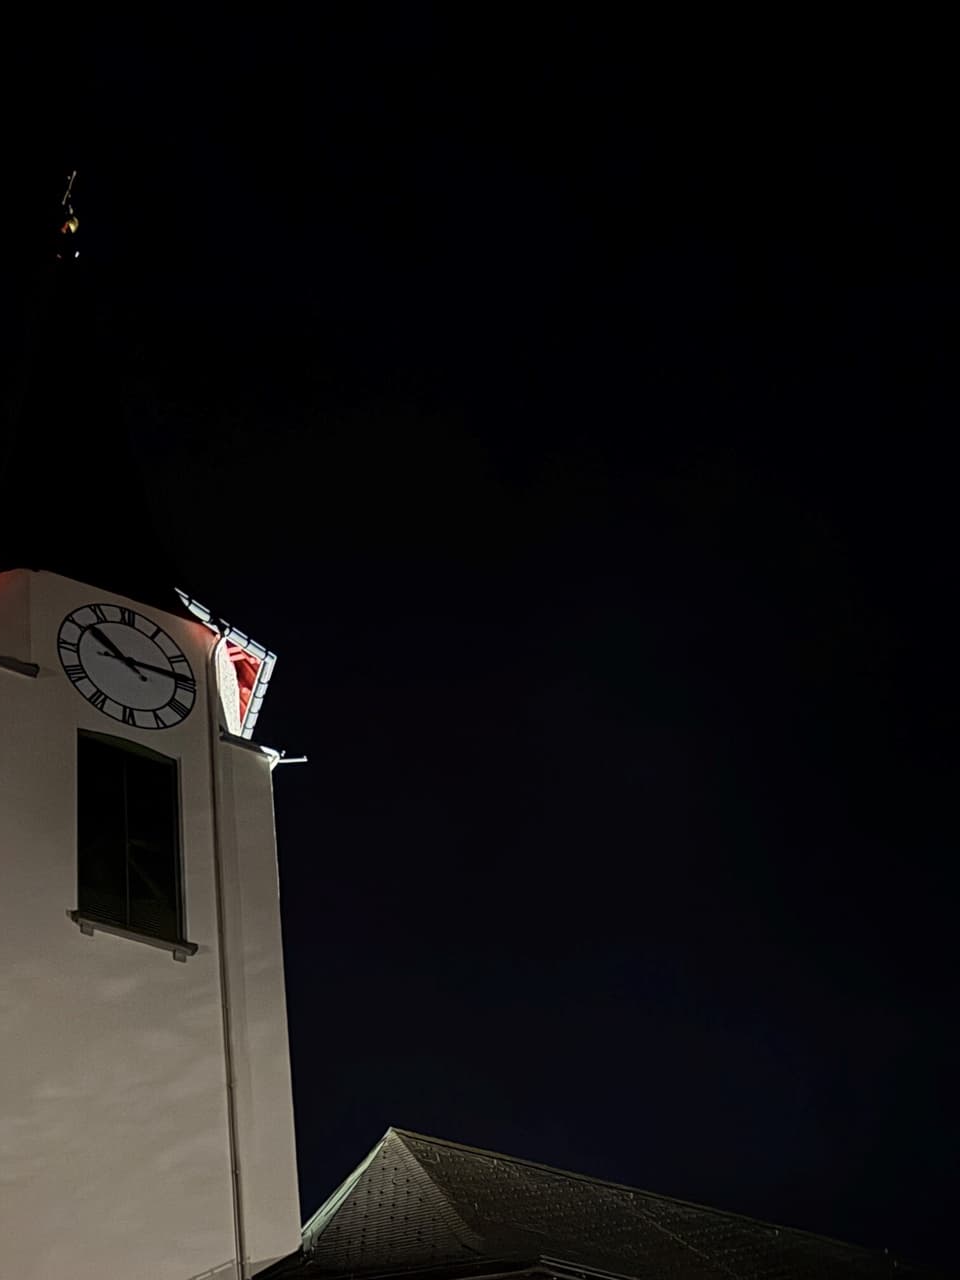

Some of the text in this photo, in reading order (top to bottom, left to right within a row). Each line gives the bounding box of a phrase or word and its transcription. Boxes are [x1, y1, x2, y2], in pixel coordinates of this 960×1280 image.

[89, 606, 107, 623] XI
[120, 608, 136, 627] XII
[67, 615, 87, 632] X
[150, 627, 162, 640] I
[59, 639, 78, 653] IX
[168, 654, 185, 663] II
[152, 710, 167, 728] V
